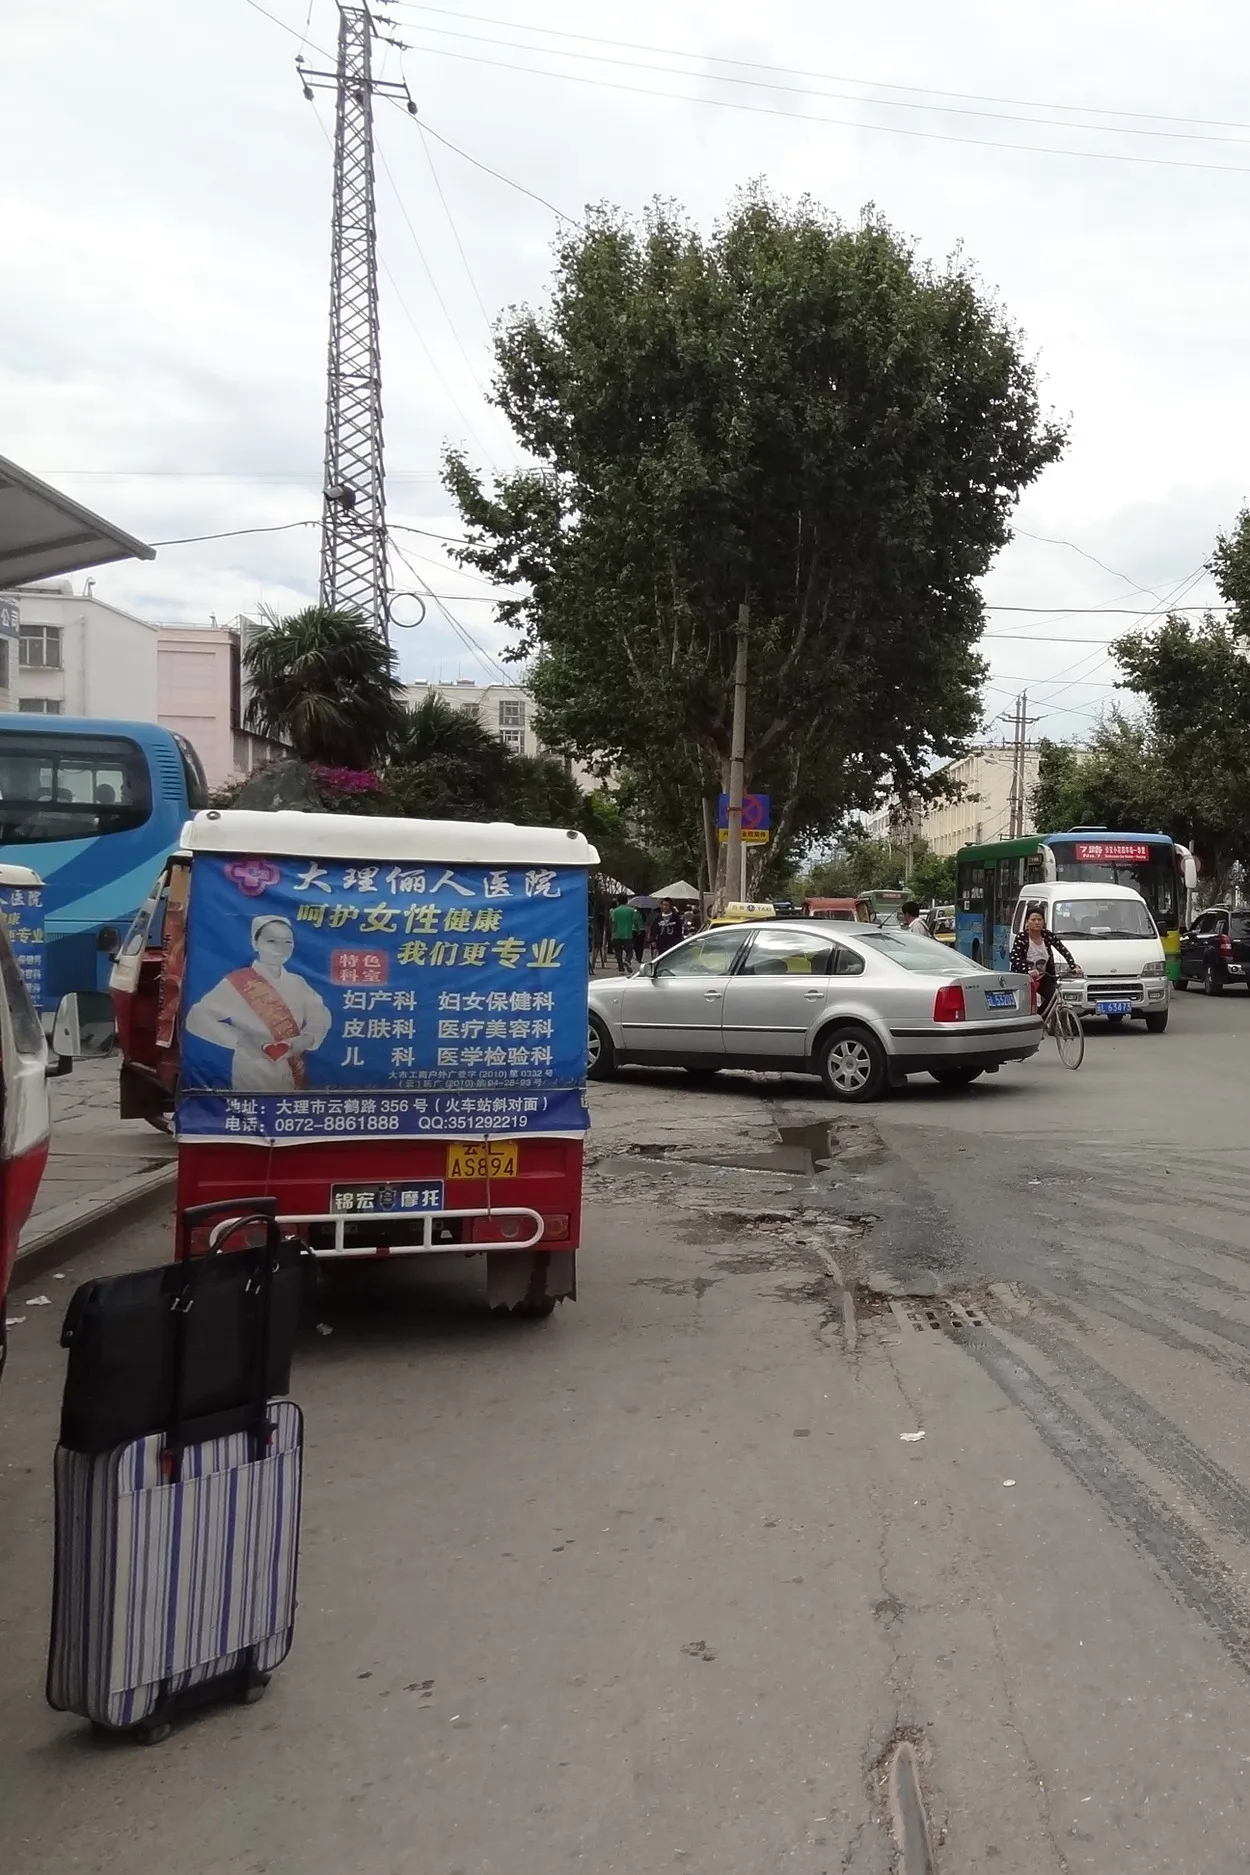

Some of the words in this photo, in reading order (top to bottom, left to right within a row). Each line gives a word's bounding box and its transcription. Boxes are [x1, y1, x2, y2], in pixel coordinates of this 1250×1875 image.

[293, 860, 561, 898] 大理俪人医院
[0, 889, 43, 908] 医院
[296, 901, 504, 934] 呵护女性健康
[340, 952, 382, 968] 特色
[397, 937, 565, 968] 我们更专业
[340, 968, 382, 983] 科室
[342, 989, 417, 1012] 妇产科
[438, 990, 555, 1012] 妇女保健科
[341, 1018, 416, 1040] 皮肤科
[438, 1018, 555, 1040] 医疗美容科
[437, 1045, 554, 1067] 医学检验科
[418, 1115, 528, 1130] QQ:351292219
[451, 1157, 515, 1177] AS894
[335, 1191, 375, 1210] 锦宏
[401, 1189, 440, 1208] 摩托
